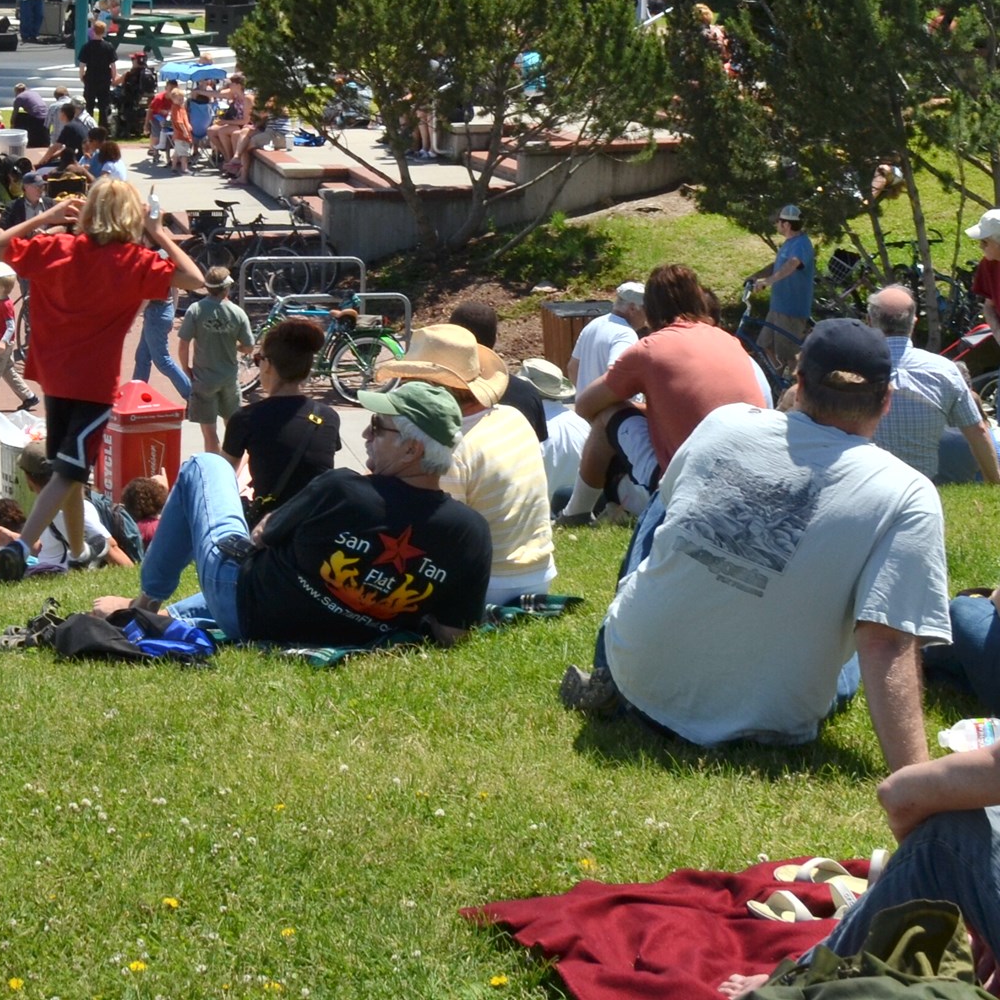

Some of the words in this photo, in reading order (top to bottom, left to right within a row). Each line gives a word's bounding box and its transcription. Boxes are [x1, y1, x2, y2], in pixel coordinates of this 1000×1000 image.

[103, 433, 113, 500] ECYCLE
[334, 531, 371, 553] San
[418, 557, 447, 583] Tan
[364, 568, 397, 590] Flat
